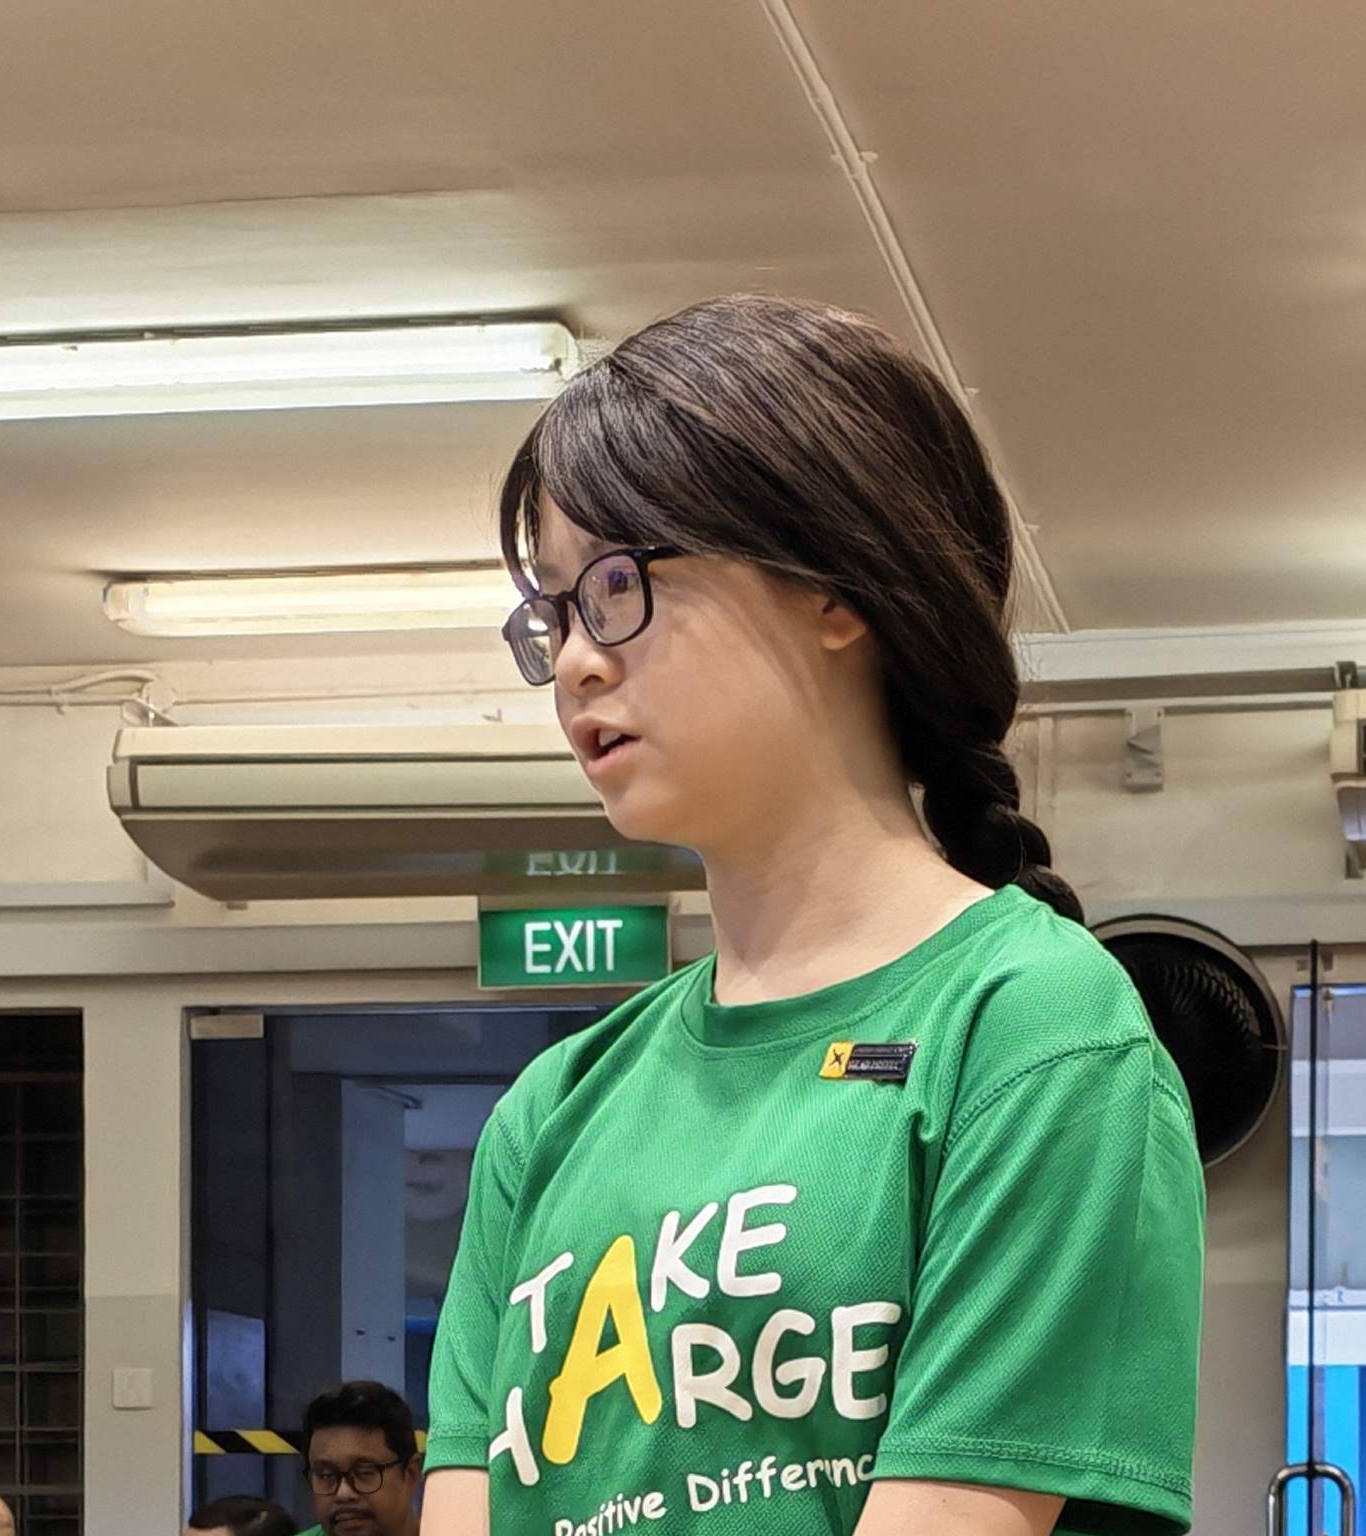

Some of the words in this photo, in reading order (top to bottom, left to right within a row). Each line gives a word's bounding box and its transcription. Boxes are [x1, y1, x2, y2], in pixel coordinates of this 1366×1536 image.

[524, 919, 623, 974] EXIT
[489, 1234, 902, 1486] HARGE
[510, 1184, 798, 1465] TAKE
